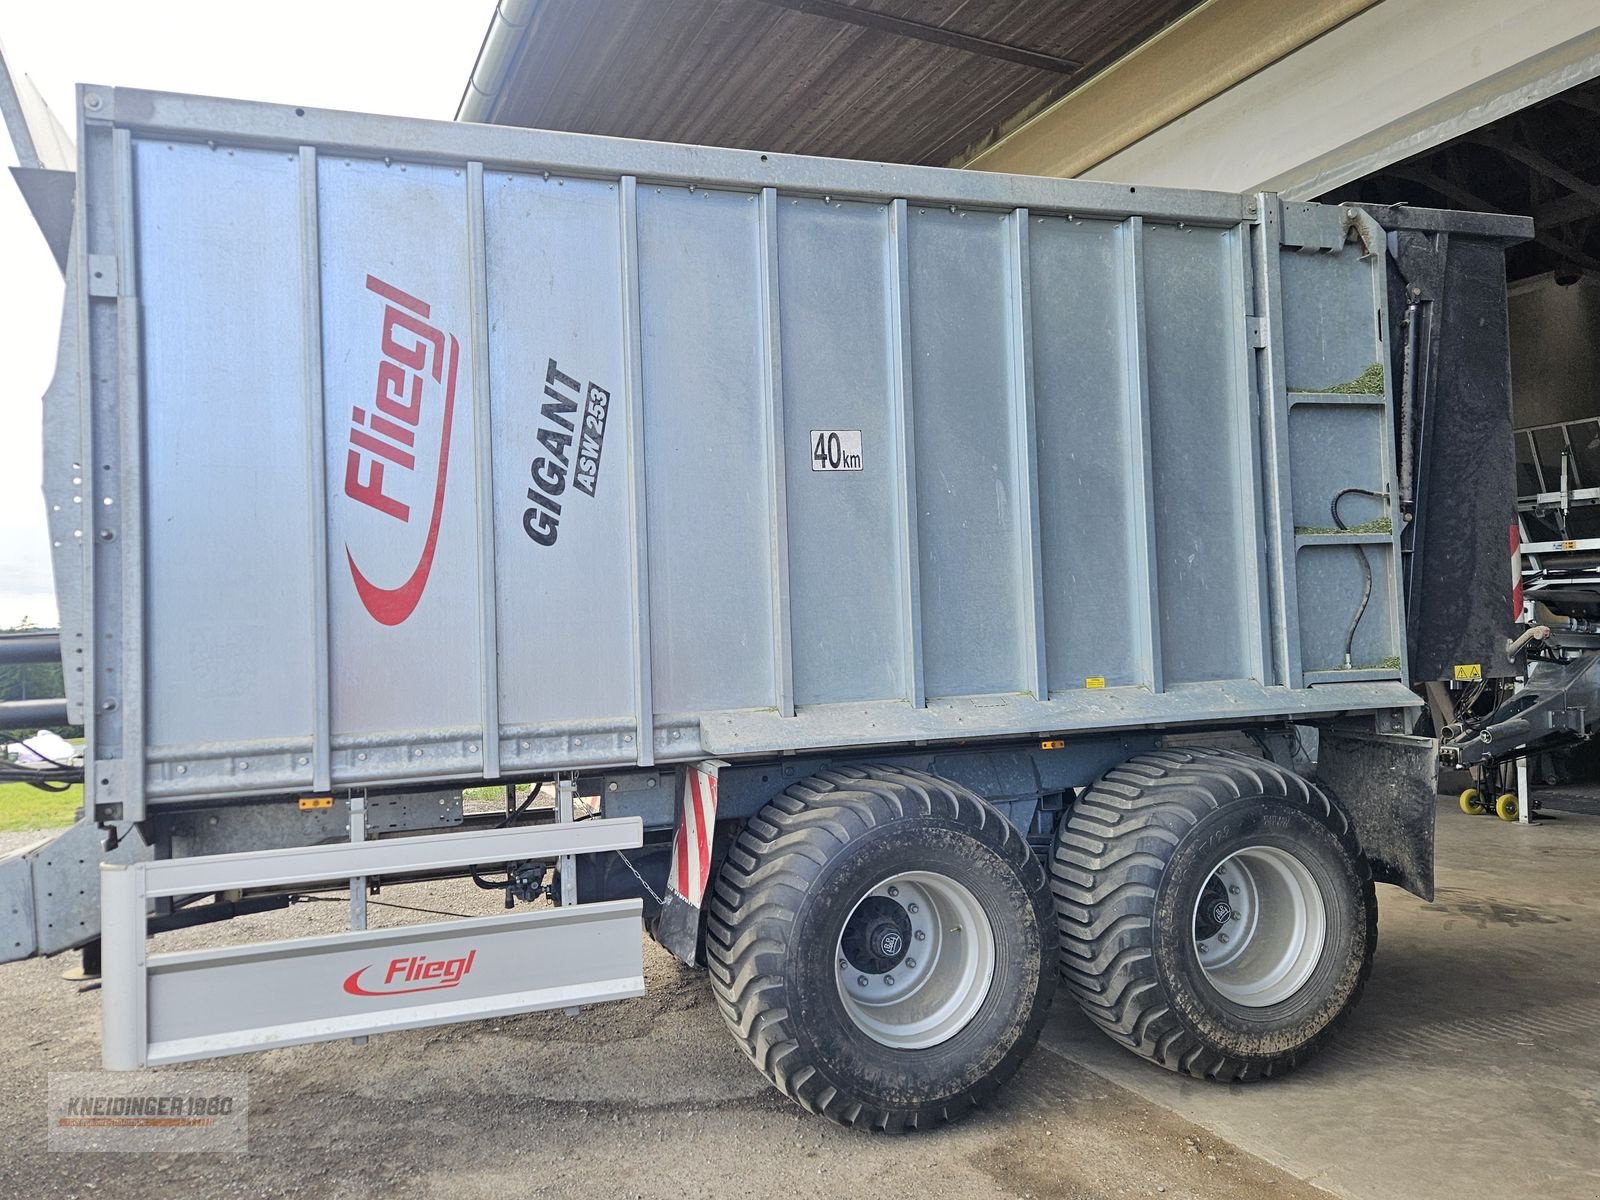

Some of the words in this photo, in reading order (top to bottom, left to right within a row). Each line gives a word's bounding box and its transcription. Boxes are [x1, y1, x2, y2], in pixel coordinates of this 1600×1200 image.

[344, 273, 446, 523] Fliegl
[586, 388, 607, 437] 253
[522, 357, 581, 547] GIGANT
[576, 436, 602, 493] ASW
[384, 949, 477, 984] Fliegl
